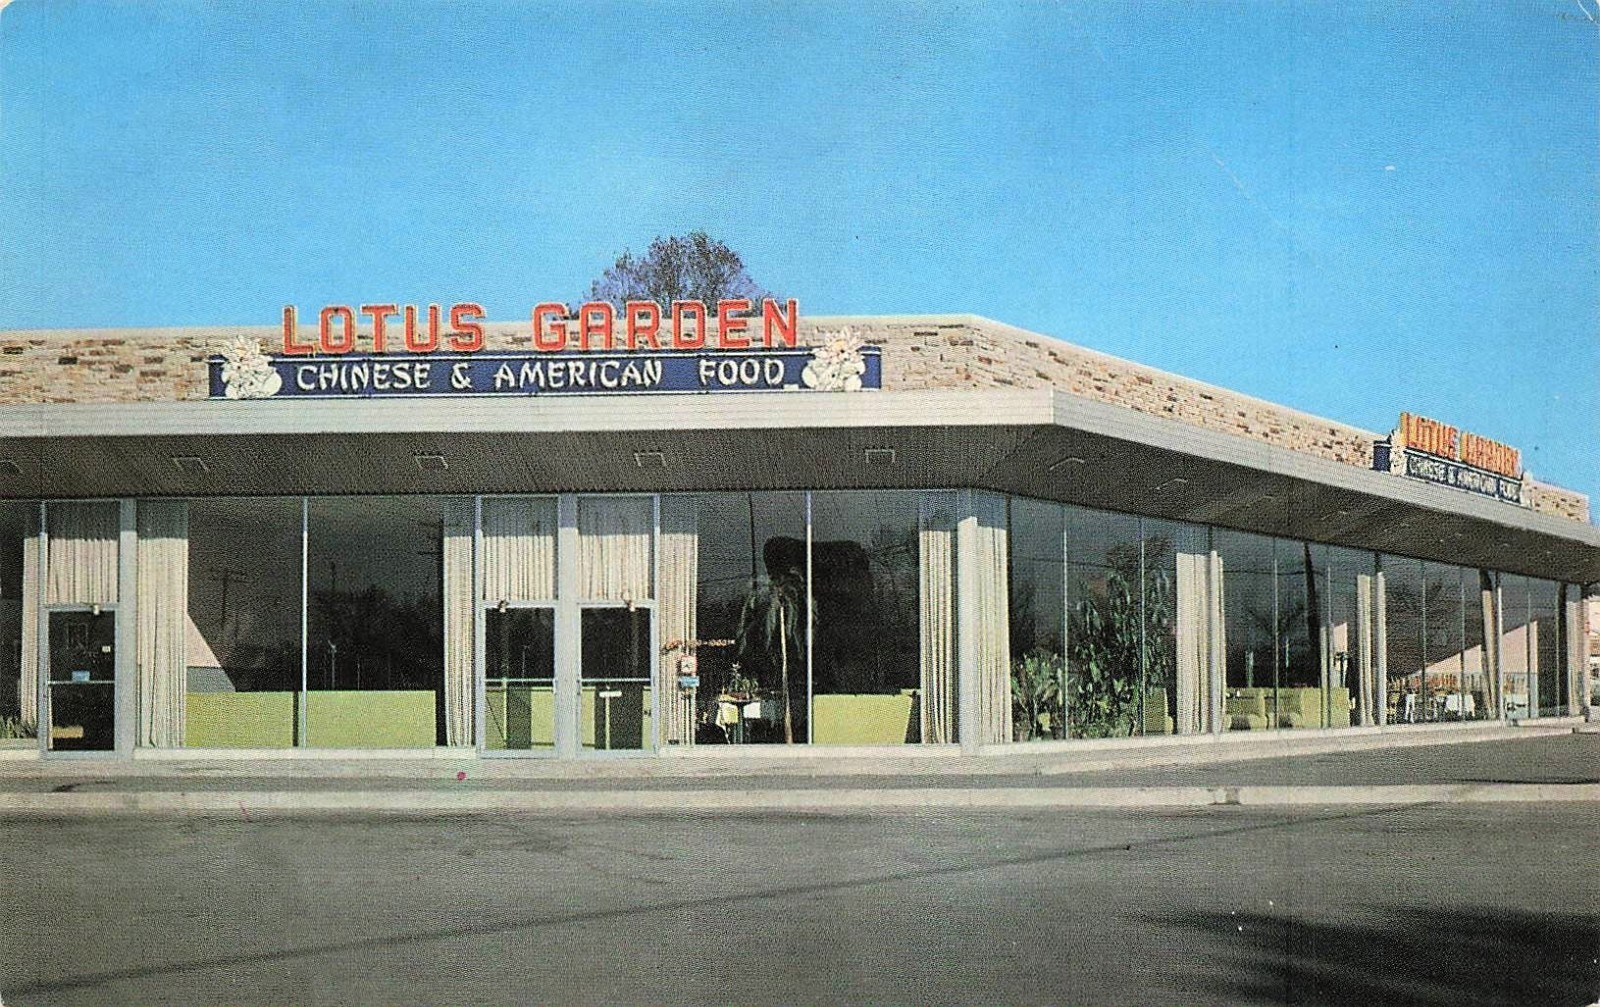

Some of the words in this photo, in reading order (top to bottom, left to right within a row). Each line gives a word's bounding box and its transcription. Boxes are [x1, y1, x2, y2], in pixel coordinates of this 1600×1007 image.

[282, 302, 486, 354] LOTUS
[532, 298, 799, 351] GARDEN
[297, 362, 430, 390] CHINESE
[450, 361, 472, 389] &
[493, 360, 663, 389] AMERICAN
[699, 358, 785, 385] FOOD
